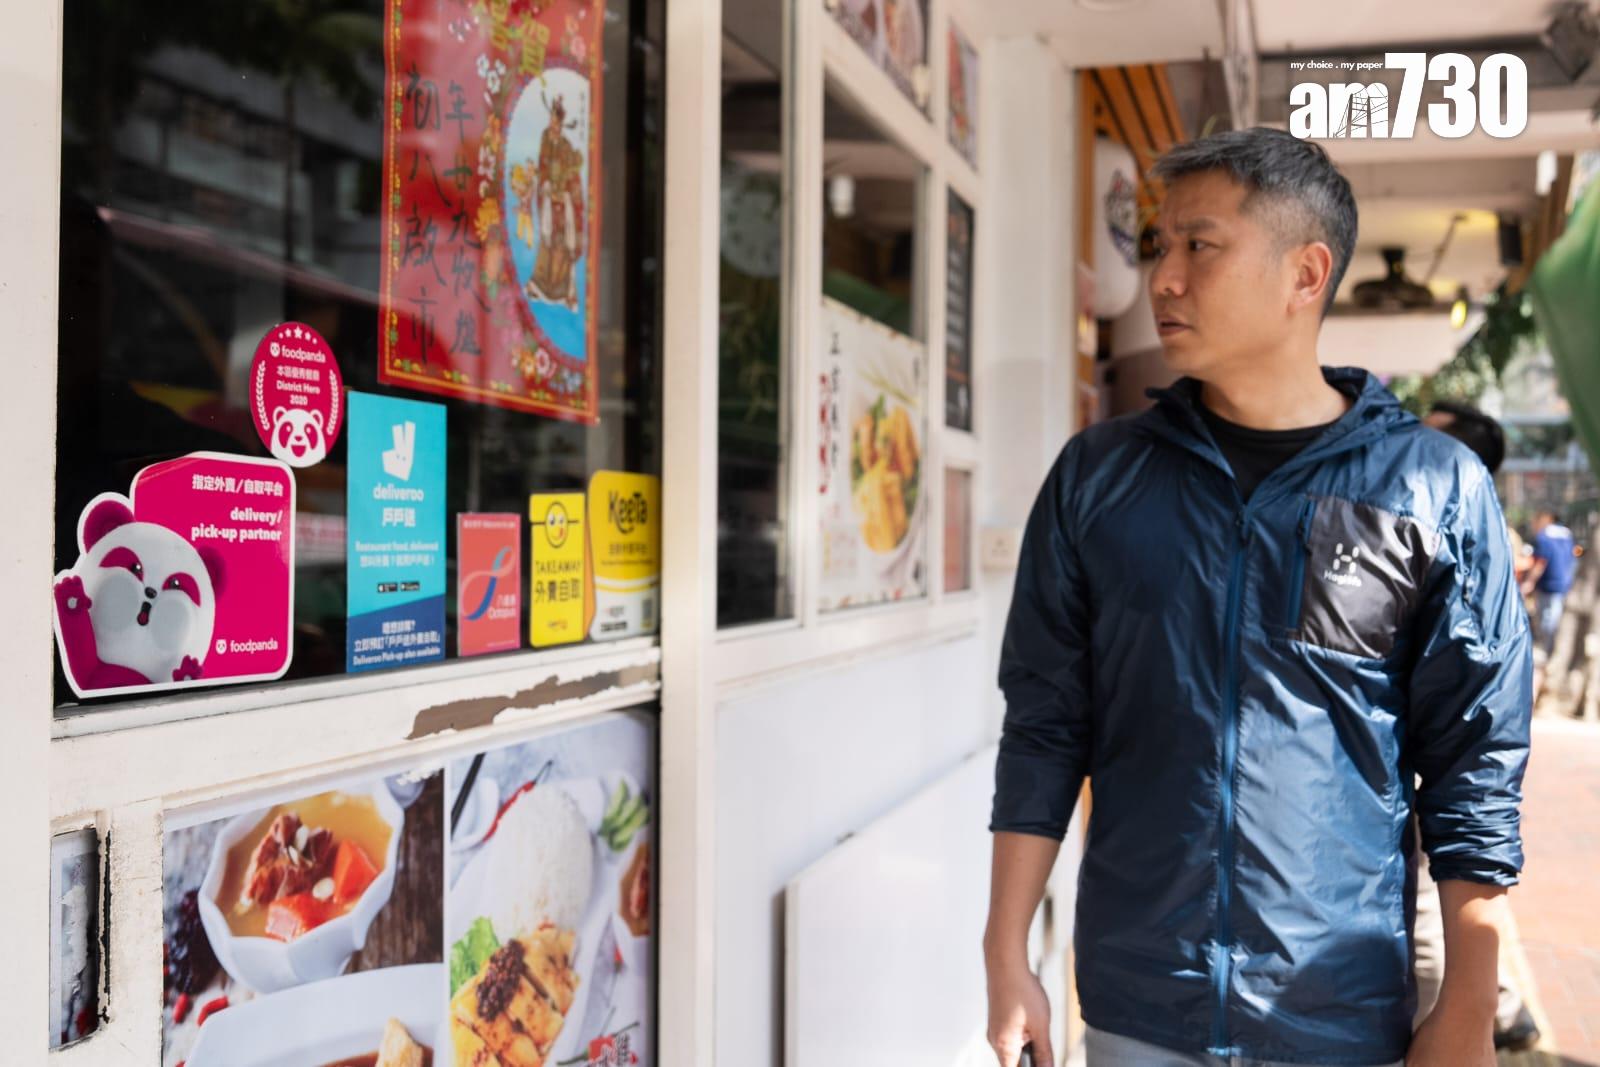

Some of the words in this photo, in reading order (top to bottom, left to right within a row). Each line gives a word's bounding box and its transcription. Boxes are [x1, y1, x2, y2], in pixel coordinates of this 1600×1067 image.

[281, 345, 326, 363] foodpanda
[276, 380, 303, 393] District
[303, 383, 321, 395] Hero
[289, 394, 308, 406] 2020
[373, 482, 424, 501] deliveroo
[229, 507, 283, 526] delivery/
[191, 524, 238, 543] pick-up
[238, 528, 282, 544] partner
[535, 559, 582, 574] TAKEAWAY
[229, 638, 279, 654] foodpanda
